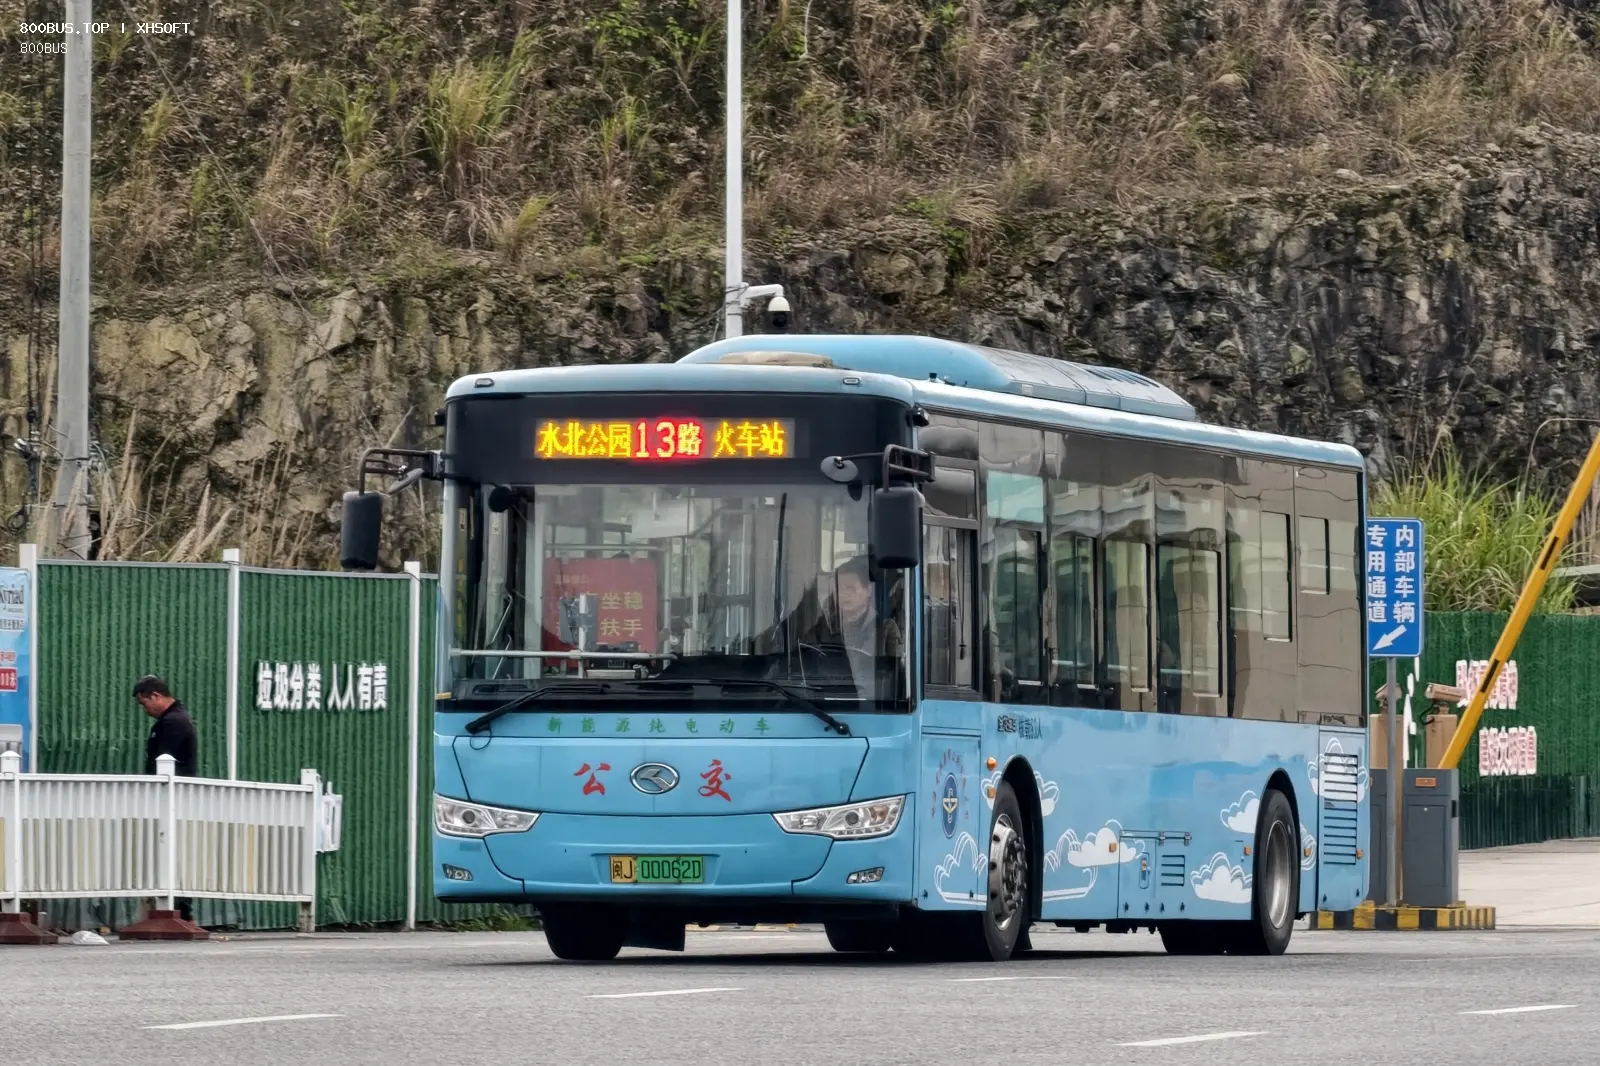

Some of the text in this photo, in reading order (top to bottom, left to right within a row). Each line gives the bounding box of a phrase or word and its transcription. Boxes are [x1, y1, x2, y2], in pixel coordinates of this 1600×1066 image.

[538, 421, 785, 458] 水北公园 13路 火车站
[1367, 524, 1388, 623] 专用通道
[1393, 524, 1416, 623] 内部车辆
[256, 661, 388, 710] 垃圾分类 人人有责
[547, 716, 771, 735] 新能源纯电动车
[573, 758, 732, 802] 公交
